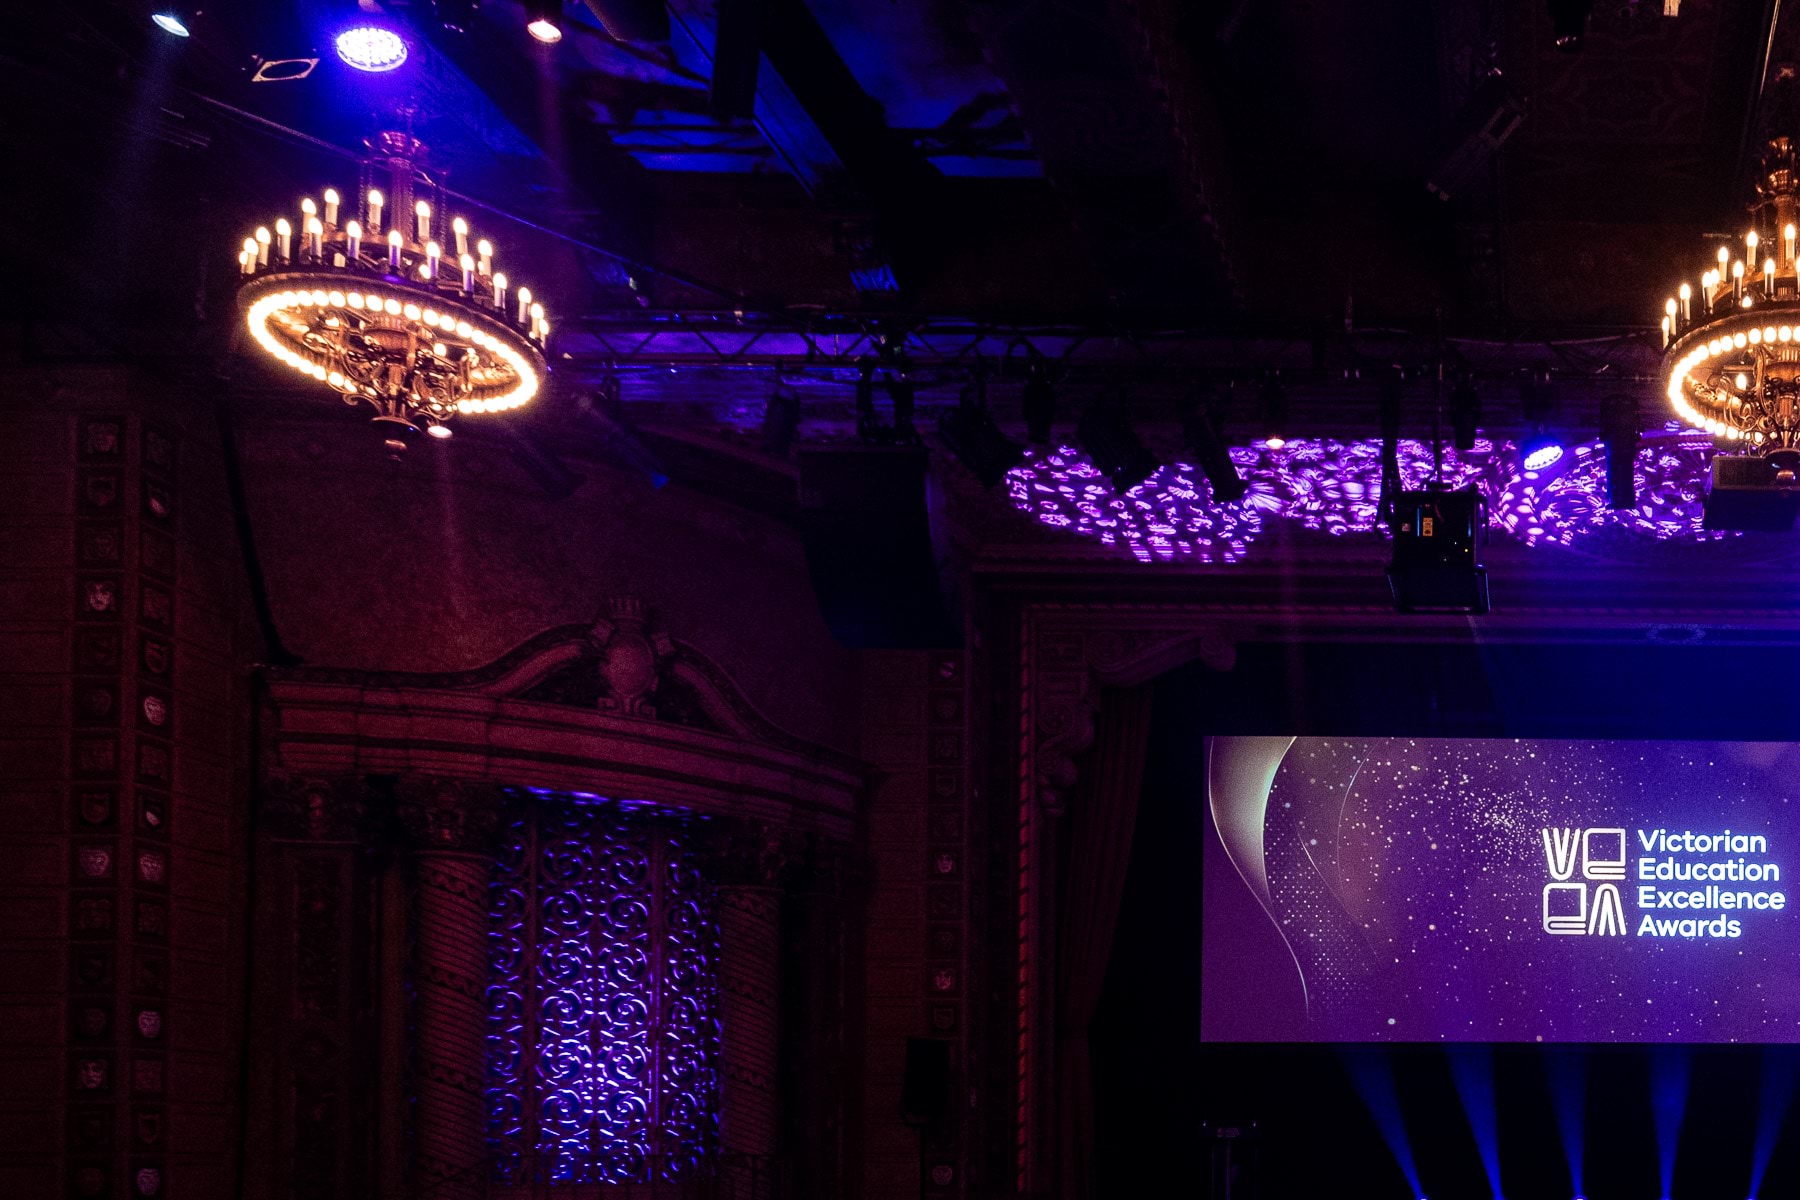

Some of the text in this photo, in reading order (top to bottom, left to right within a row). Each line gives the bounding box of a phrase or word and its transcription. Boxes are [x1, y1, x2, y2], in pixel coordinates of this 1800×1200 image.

[1637, 828, 1767, 853] Victorian
[1638, 856, 1780, 881] Education
[1638, 885, 1786, 910] Excellence
[1637, 913, 1742, 938] Awards
